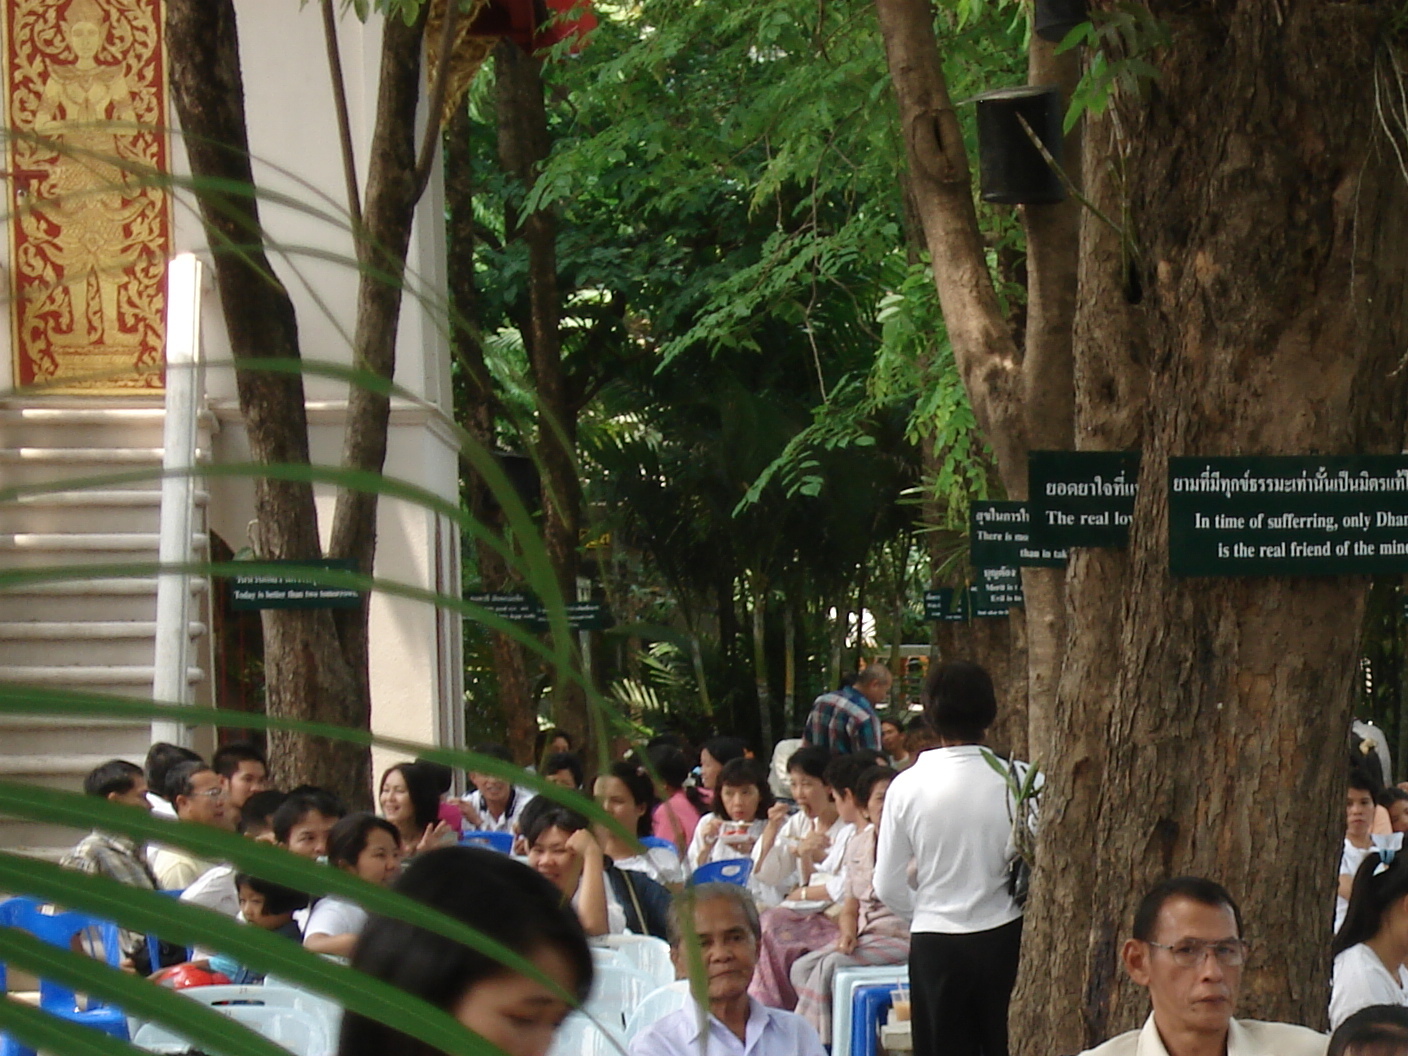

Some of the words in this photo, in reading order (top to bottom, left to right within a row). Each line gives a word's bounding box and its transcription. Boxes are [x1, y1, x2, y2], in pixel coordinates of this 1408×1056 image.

[1045, 510, 1074, 526] The
[1080, 510, 1109, 526] real
[1115, 510, 1135, 526] lov
[1195, 512, 1210, 529] In
[1215, 513, 1245, 529] time
[1249, 512, 1265, 529] of
[1267, 512, 1339, 533] sufferring,
[1342, 511, 1372, 532] only
[977, 530, 1003, 542] There
[1014, 533, 1030, 542] mo
[1053, 549, 1068, 559] tak
[1218, 542, 1230, 558] is
[1233, 541, 1256, 558] the
[1259, 541, 1286, 558] real
[1290, 541, 1331, 557] friend
[1335, 540, 1351, 557] of
[1354, 540, 1376, 556] the
[234, 590, 256, 600] Today
[266, 590, 286, 599] better
[288, 590, 304, 599] than
[305, 590, 318, 599] two
